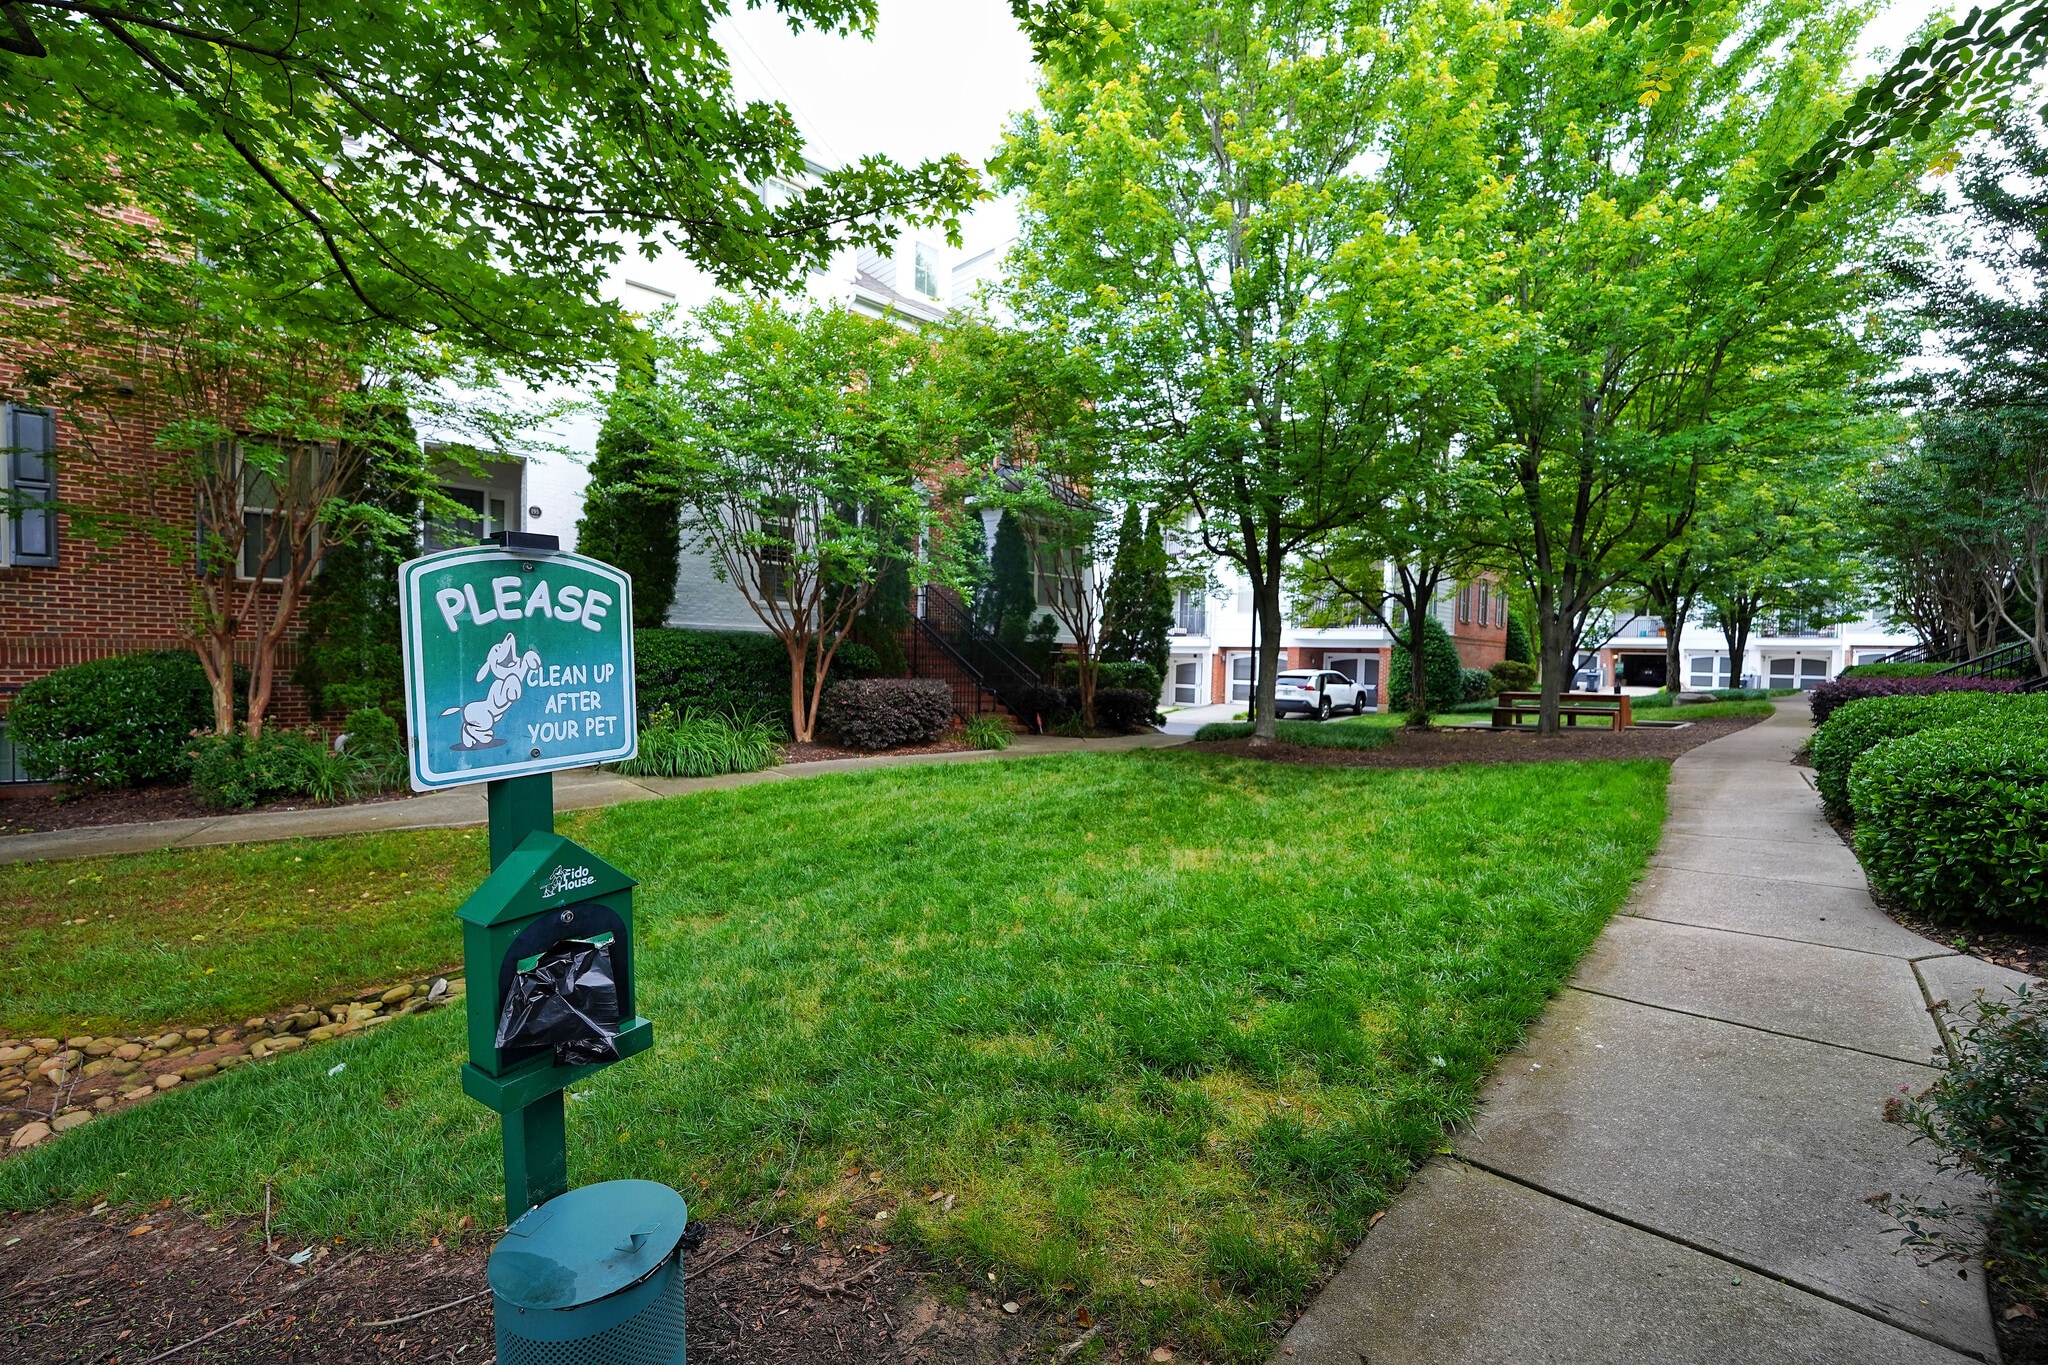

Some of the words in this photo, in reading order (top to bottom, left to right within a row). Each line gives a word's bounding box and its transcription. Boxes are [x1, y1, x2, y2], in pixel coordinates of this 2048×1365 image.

[435, 576, 613, 632] PLEASE
[527, 664, 587, 687] CLEAN
[593, 663, 615, 683] UP
[545, 691, 601, 713] AFTER
[527, 721, 579, 744] YOUR
[586, 716, 617, 737] PET
[557, 876, 595, 892] House
[563, 865, 589, 881] Fido
